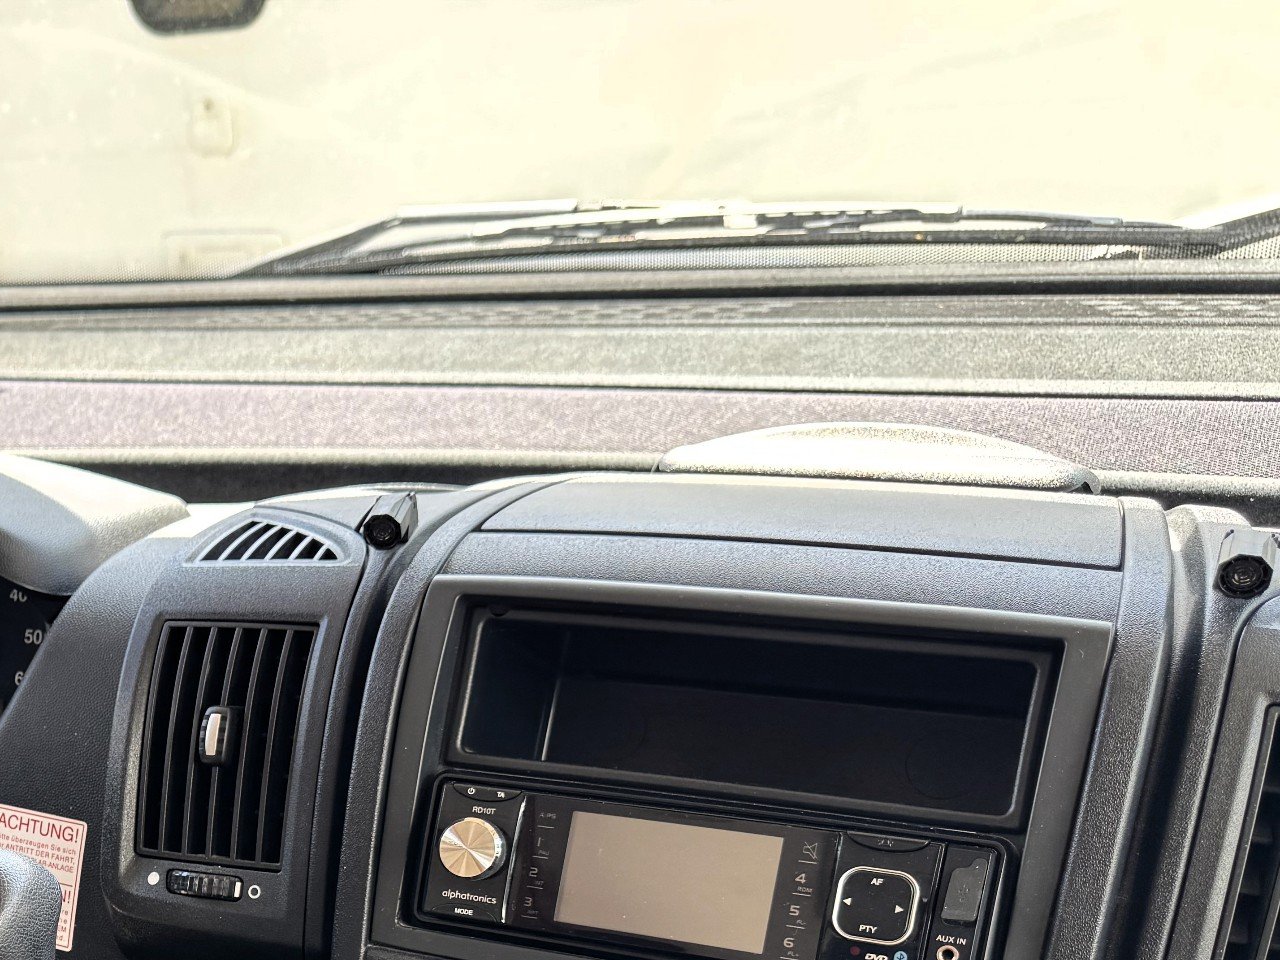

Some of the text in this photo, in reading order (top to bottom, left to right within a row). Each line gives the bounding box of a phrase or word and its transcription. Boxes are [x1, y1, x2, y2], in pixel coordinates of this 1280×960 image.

[24, 629, 42, 644] 50
[472, 805, 496, 815] RD10T
[11, 834, 49, 849] überzeugen
[51, 843, 61, 852] Sie
[63, 847, 76, 855] sich
[5, 843, 34, 855] ANTRITT
[36, 849, 49, 858] DER
[529, 867, 538, 877] 2
[795, 873, 806, 884] 4
[871, 877, 884, 886] AF
[442, 888, 497, 904] alphatronics
[523, 896, 533, 907] 3
[454, 907, 474, 916] MODE
[789, 905, 800, 916] 5
[859, 924, 878, 934] PTY
[783, 937, 795, 948] 6
[936, 934, 967, 946] AUX IN
